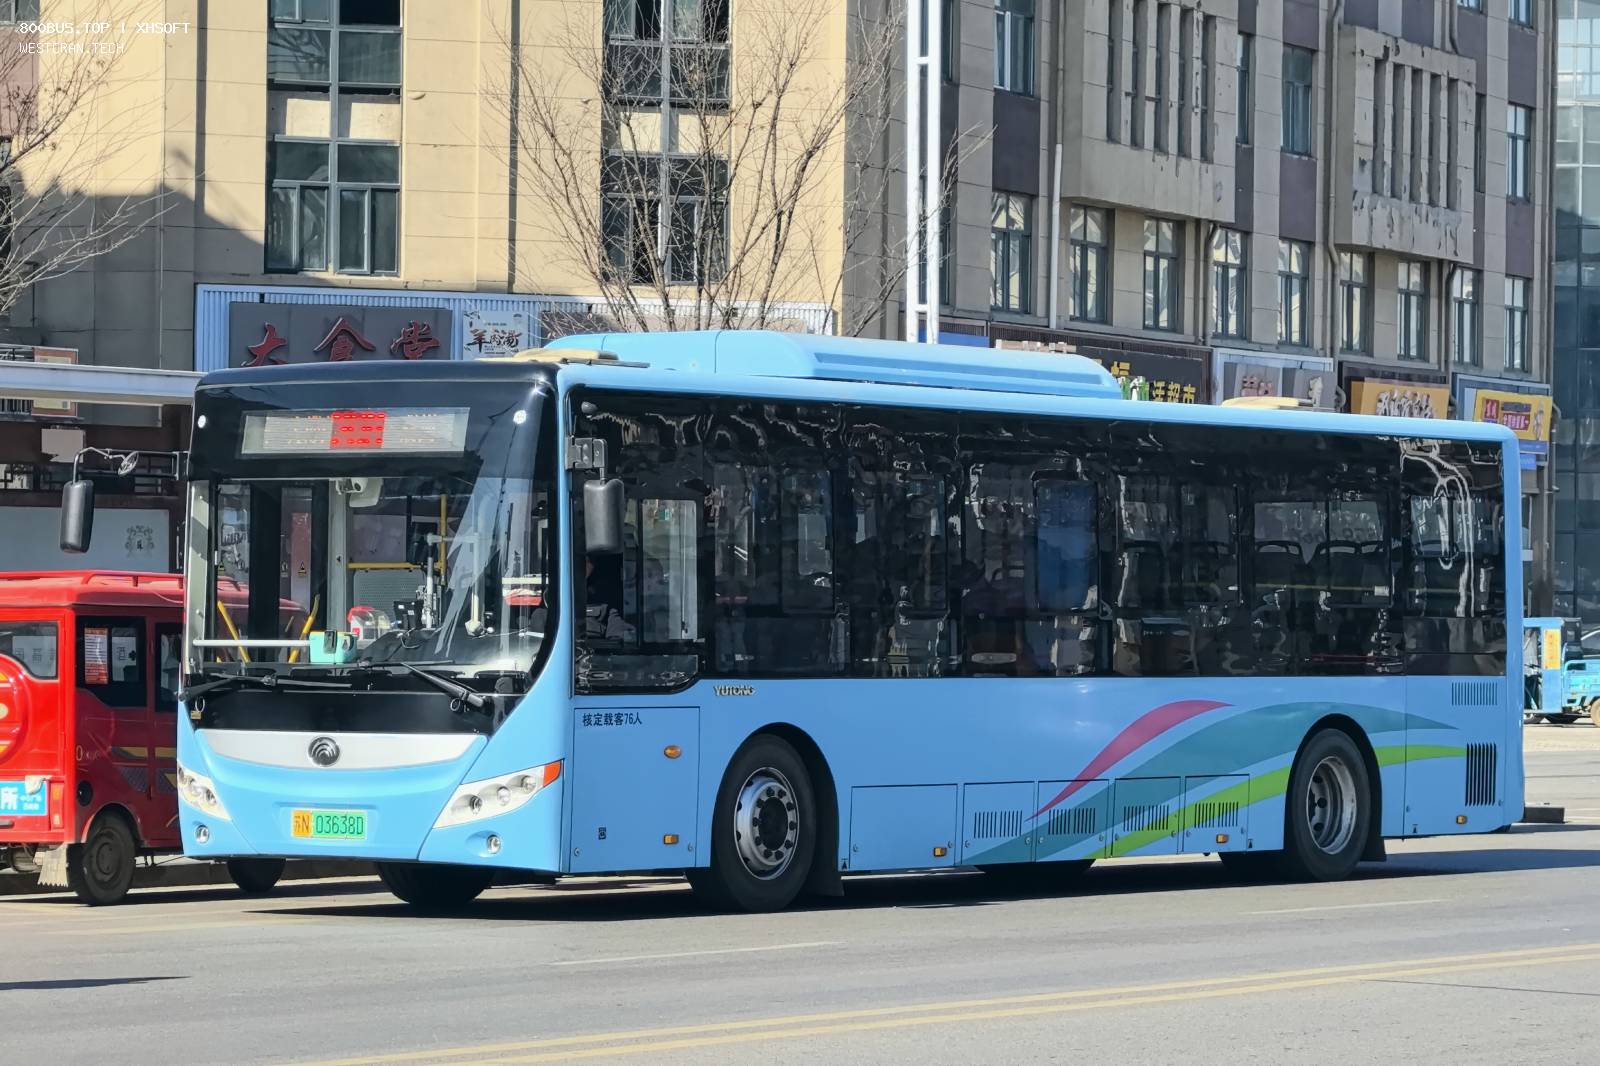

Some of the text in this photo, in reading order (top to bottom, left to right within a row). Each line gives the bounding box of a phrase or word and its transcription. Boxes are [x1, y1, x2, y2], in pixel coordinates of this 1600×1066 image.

[713, 685, 756, 697] YUTONG
[582, 712, 643, 727] 核定载客76人
